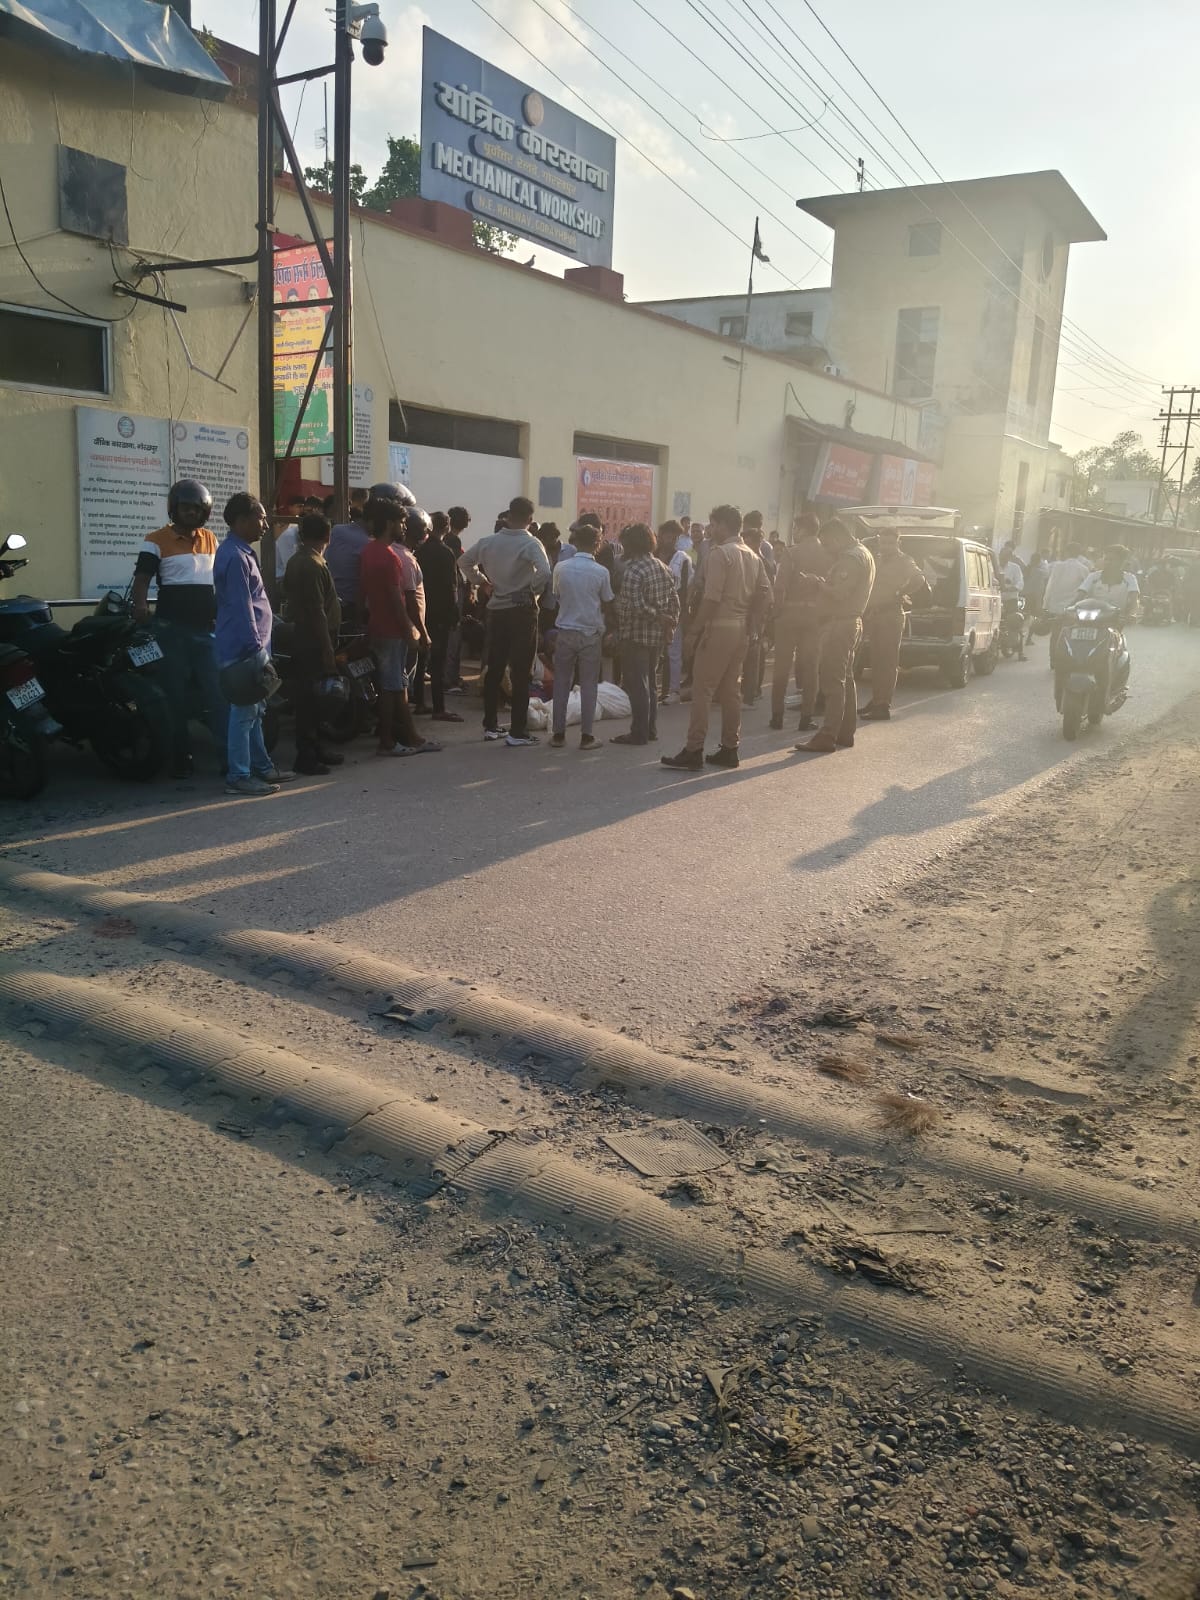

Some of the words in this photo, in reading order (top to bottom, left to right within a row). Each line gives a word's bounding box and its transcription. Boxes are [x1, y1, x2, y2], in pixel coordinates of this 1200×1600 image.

[435, 141, 537, 210] MECHANICAL
[437, 81, 515, 140] यांत्रिक
[519, 124, 609, 191] कारखाना
